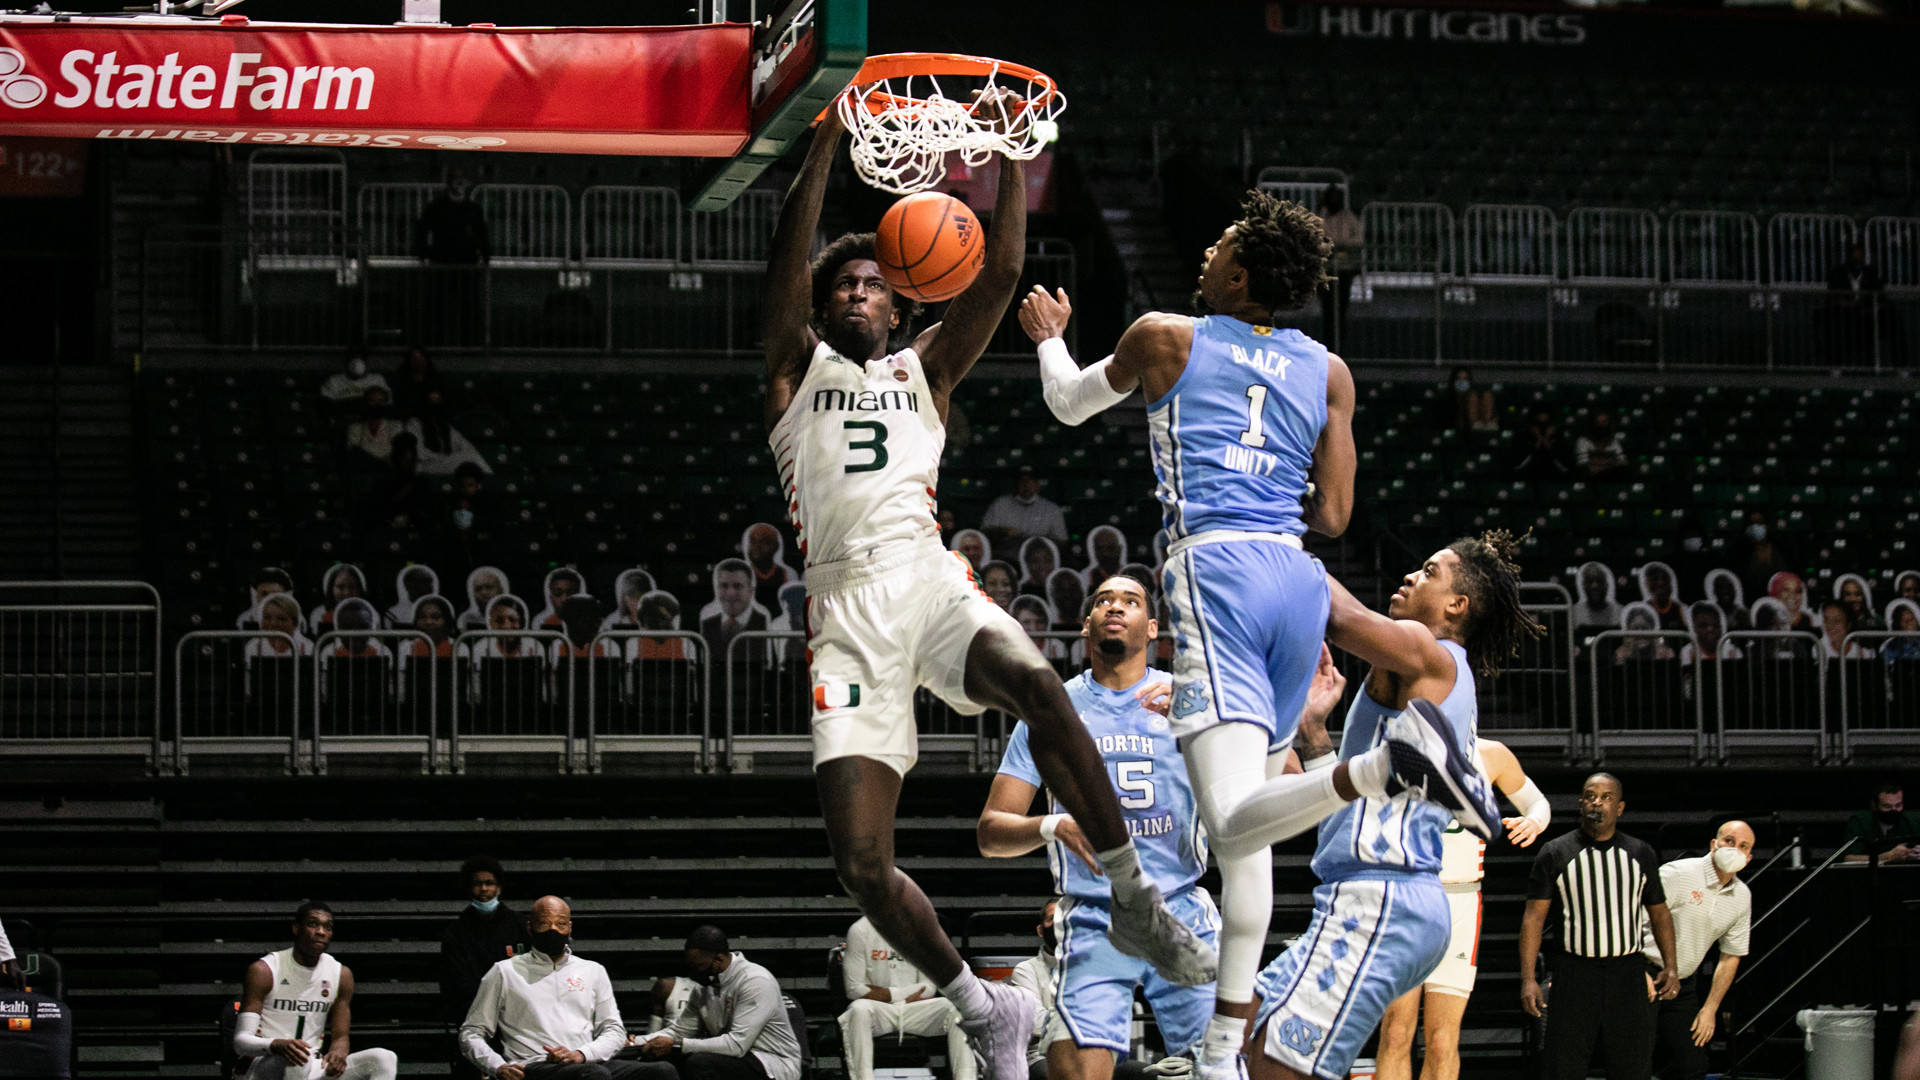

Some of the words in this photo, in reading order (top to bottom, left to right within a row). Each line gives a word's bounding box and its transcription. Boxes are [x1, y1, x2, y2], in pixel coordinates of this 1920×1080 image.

[15, 151, 63, 177] 122
[1230, 343, 1292, 380] BLACK
[1239, 383, 1268, 450] 1
[843, 420, 889, 474] 3
[1224, 444, 1277, 477] UNITY
[295, 1015, 306, 1040] 1
